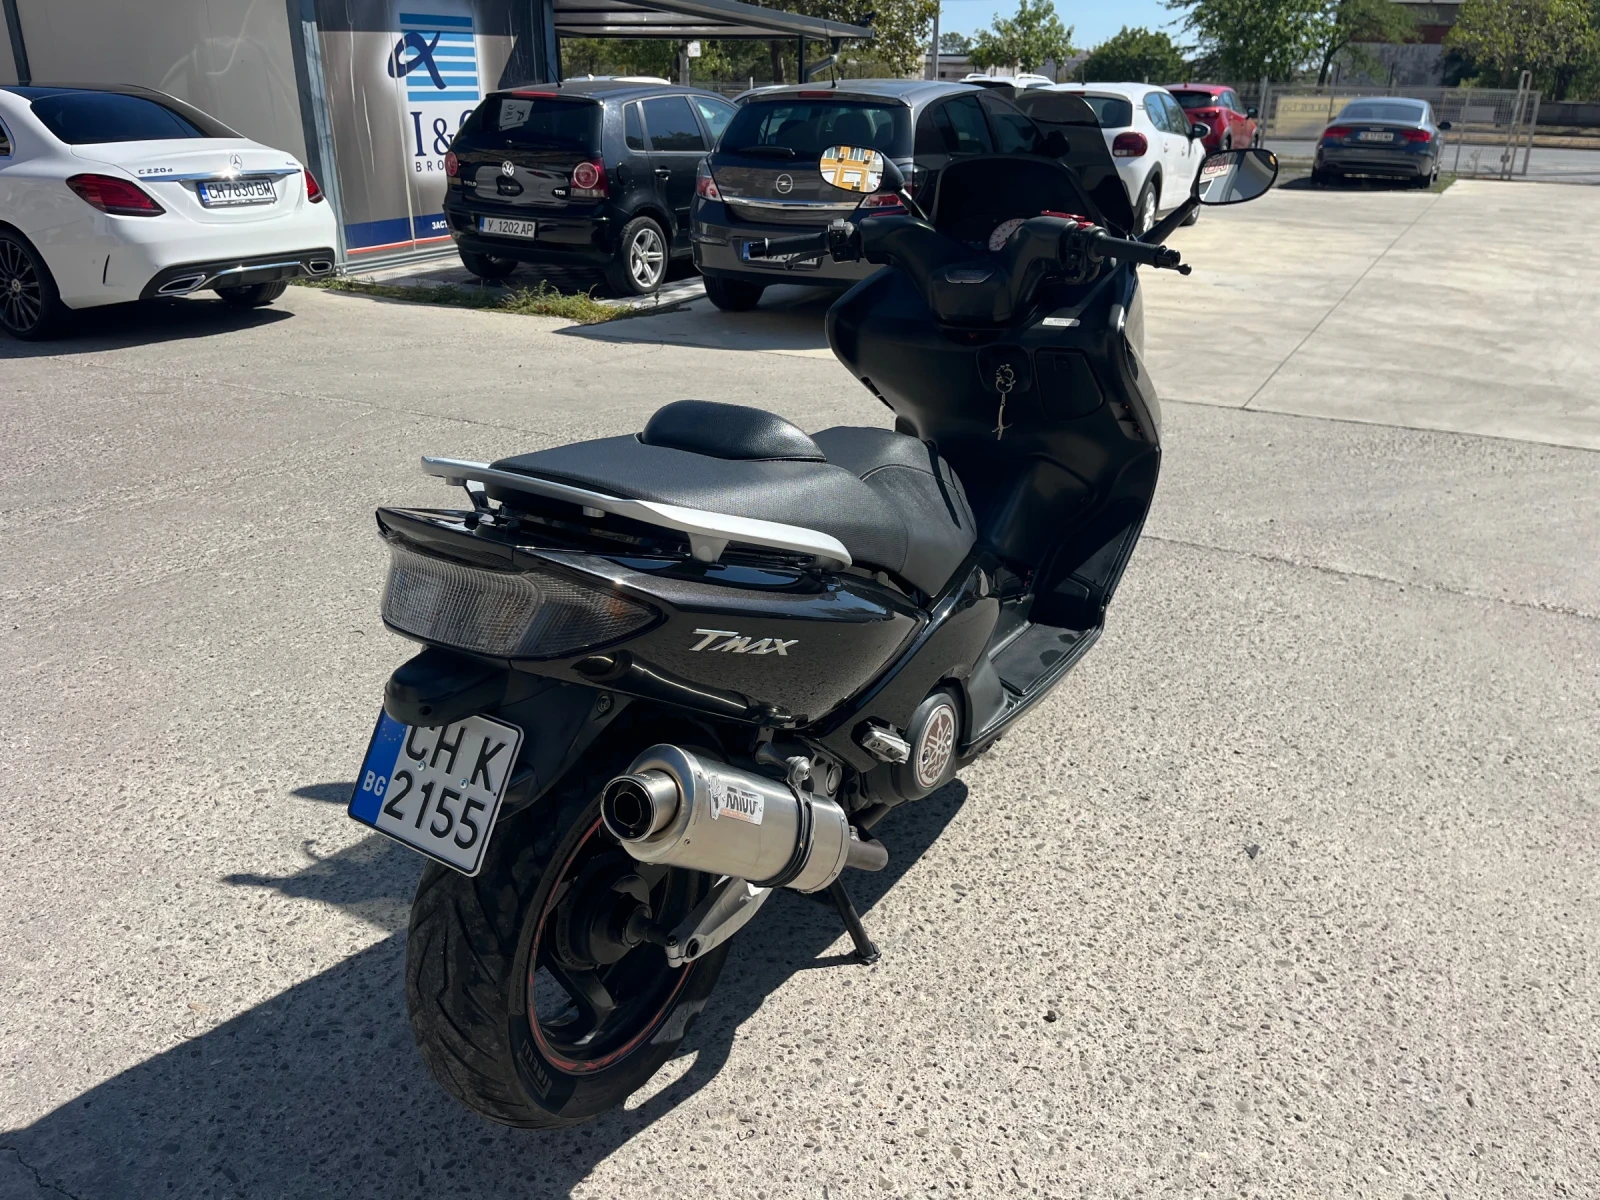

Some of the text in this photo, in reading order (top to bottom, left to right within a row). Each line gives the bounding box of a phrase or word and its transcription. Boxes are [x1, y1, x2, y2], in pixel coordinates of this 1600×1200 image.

[362, 769, 387, 797] BG
[405, 724, 507, 793] CH K
[383, 770, 486, 850] 2155
